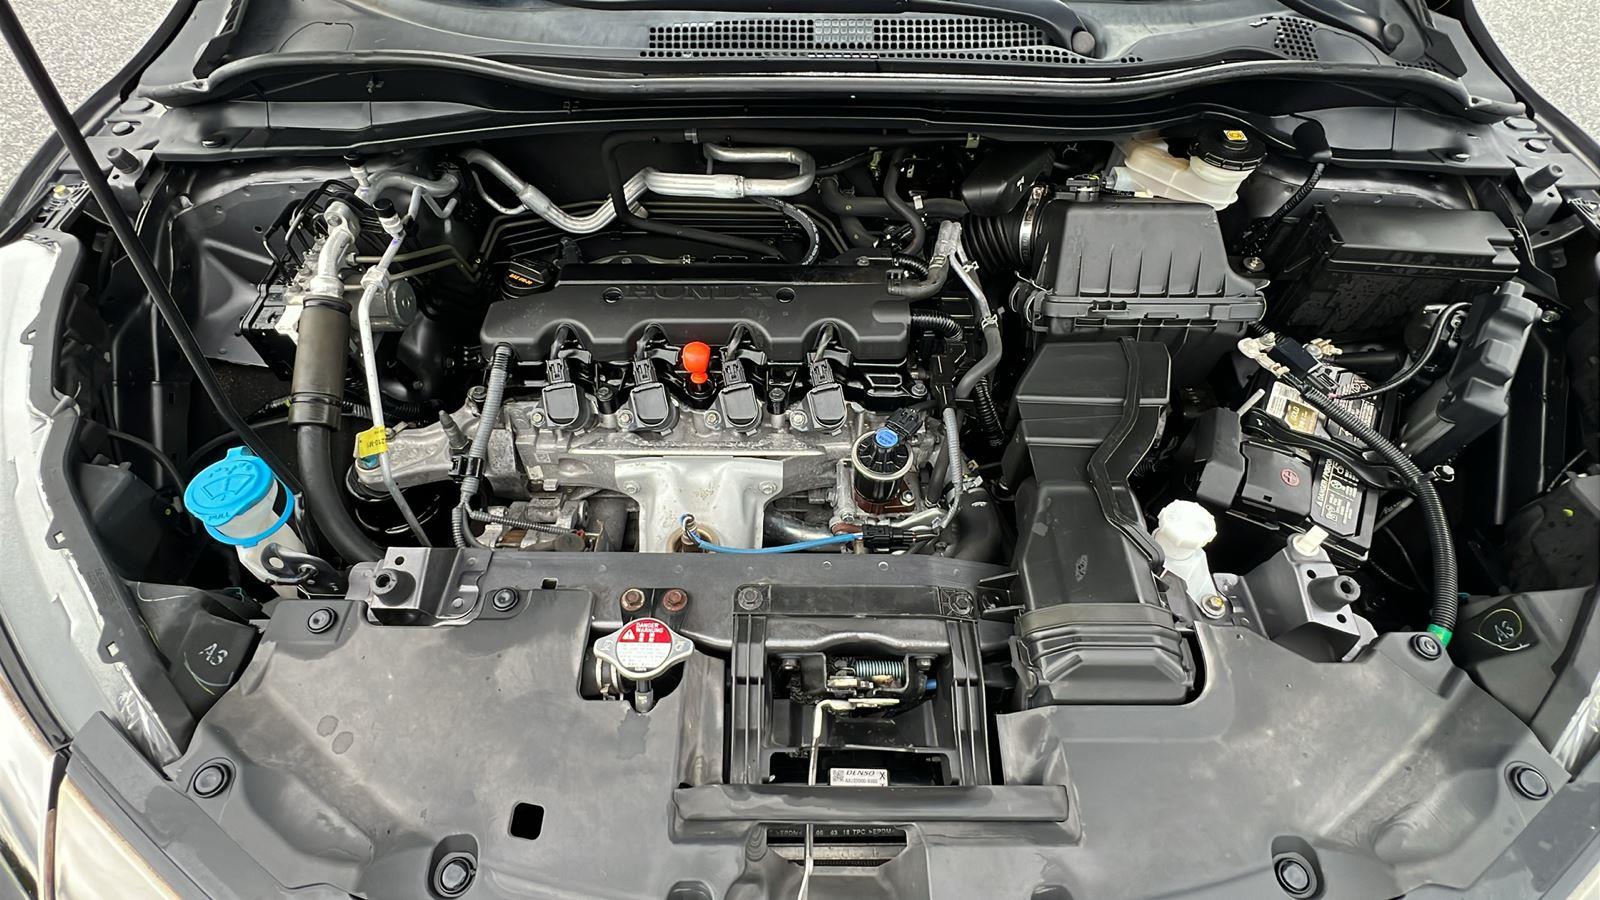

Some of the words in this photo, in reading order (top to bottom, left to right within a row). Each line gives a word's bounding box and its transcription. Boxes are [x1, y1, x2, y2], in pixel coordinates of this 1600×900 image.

[624, 285, 774, 300] HONDA
[208, 511, 230, 521] PULL
[846, 769, 876, 777] DENSO
